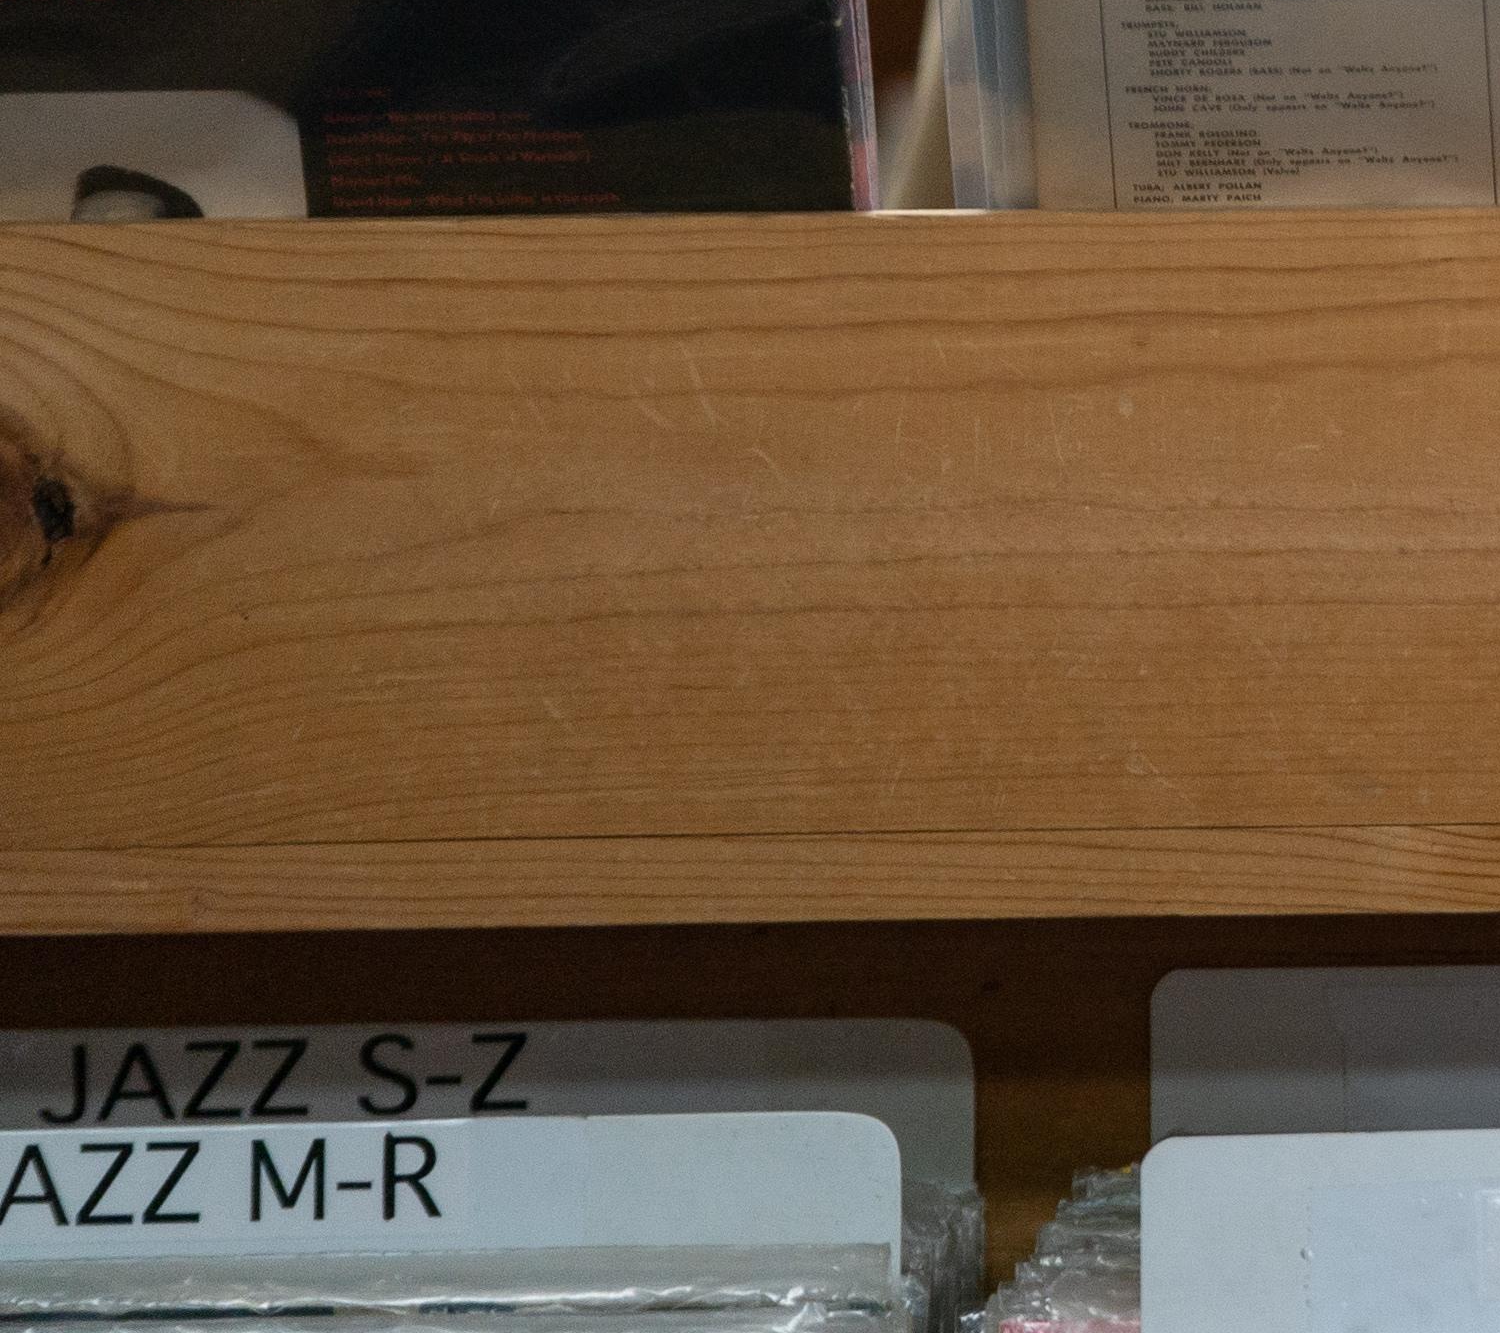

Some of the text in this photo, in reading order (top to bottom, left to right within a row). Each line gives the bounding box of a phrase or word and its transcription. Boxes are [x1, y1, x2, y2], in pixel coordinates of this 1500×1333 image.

[1173, 182, 1211, 191] ALBERT
[1218, 182, 1262, 190] POLLAN
[1181, 194, 1218, 202] MARTY
[1226, 193, 1262, 202] PAICH
[38, 1031, 529, 1125] JAZZ S-Z
[0, 1133, 442, 1226] AZZ M-R
